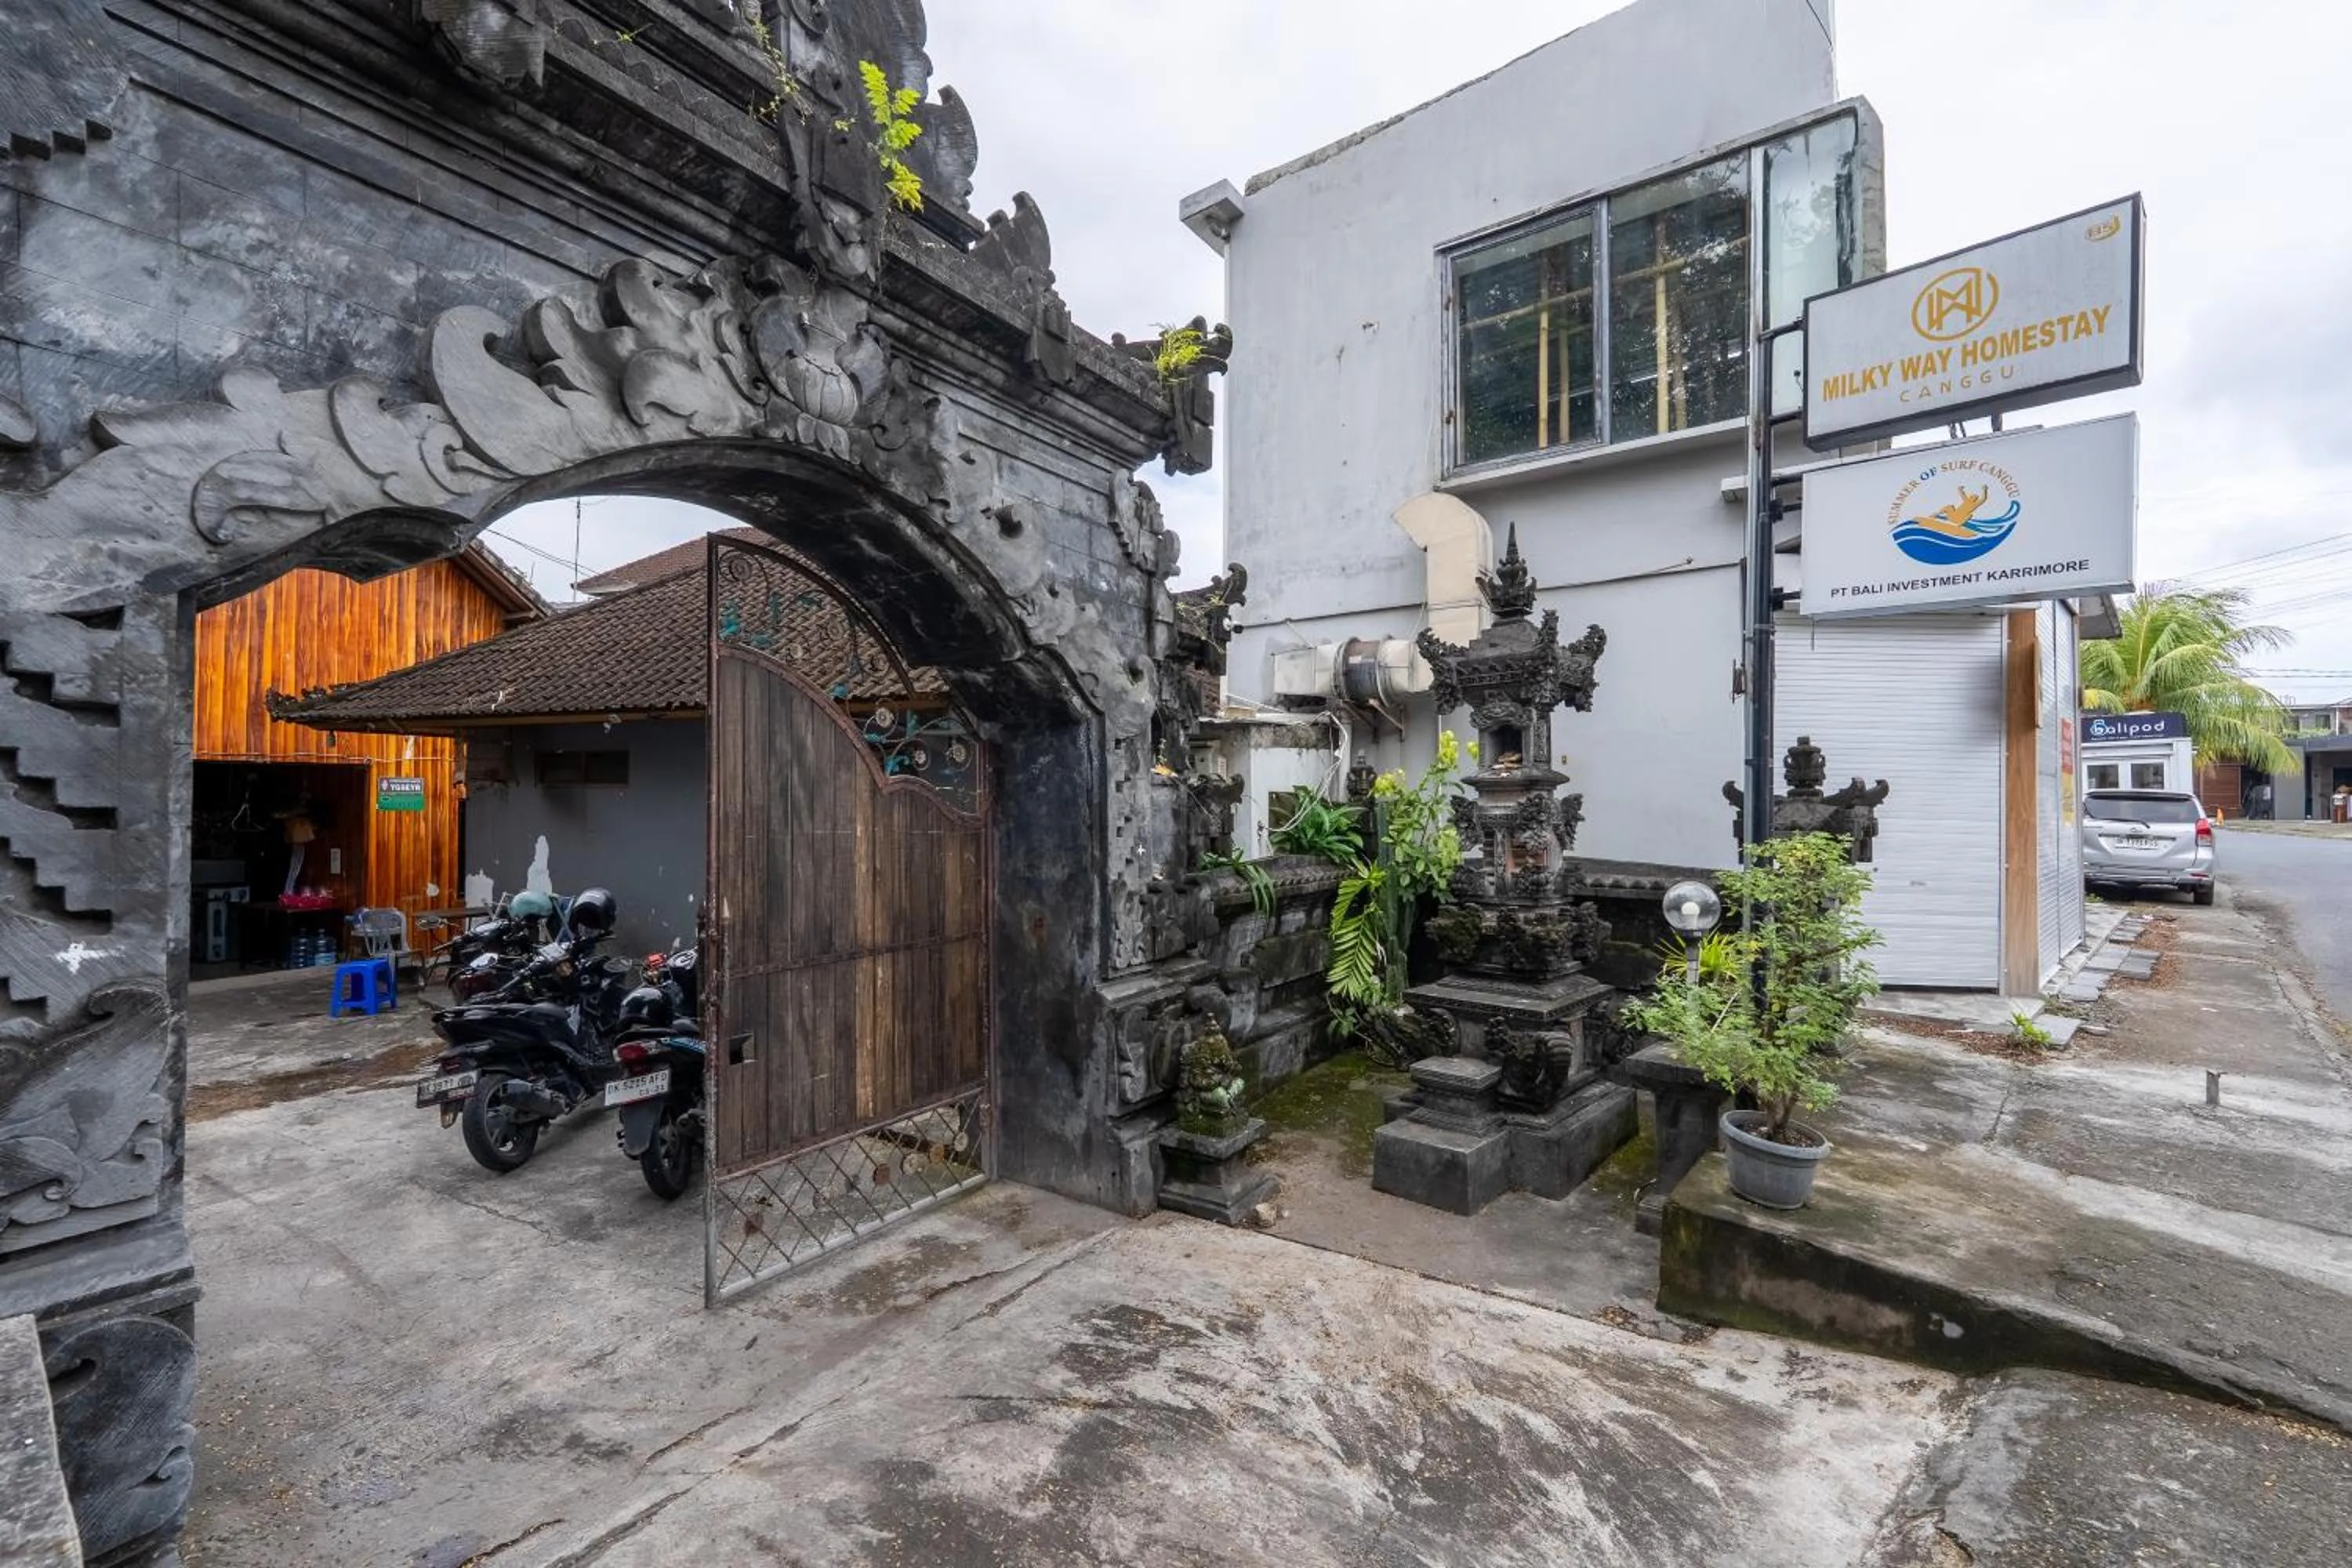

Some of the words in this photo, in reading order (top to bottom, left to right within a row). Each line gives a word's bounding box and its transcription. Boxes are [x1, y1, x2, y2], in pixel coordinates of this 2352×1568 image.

[1823, 364, 1893, 401] MILKY
[1900, 347, 1953, 382] WAY
[1961, 305, 2112, 367] HOMESTAY
[1900, 365, 2015, 402] CANGGU
[1888, 480, 1920, 525] SUMMER
[1919, 466, 1938, 481] OF
[1940, 459, 1978, 474] SURF
[1978, 462, 2021, 499] CANGGU
[1831, 588, 1848, 598] PT
[1851, 583, 1882, 597] BALI
[1886, 572, 1982, 593] INVESTMENT
[1986, 559, 2090, 581] KARRIMORE
